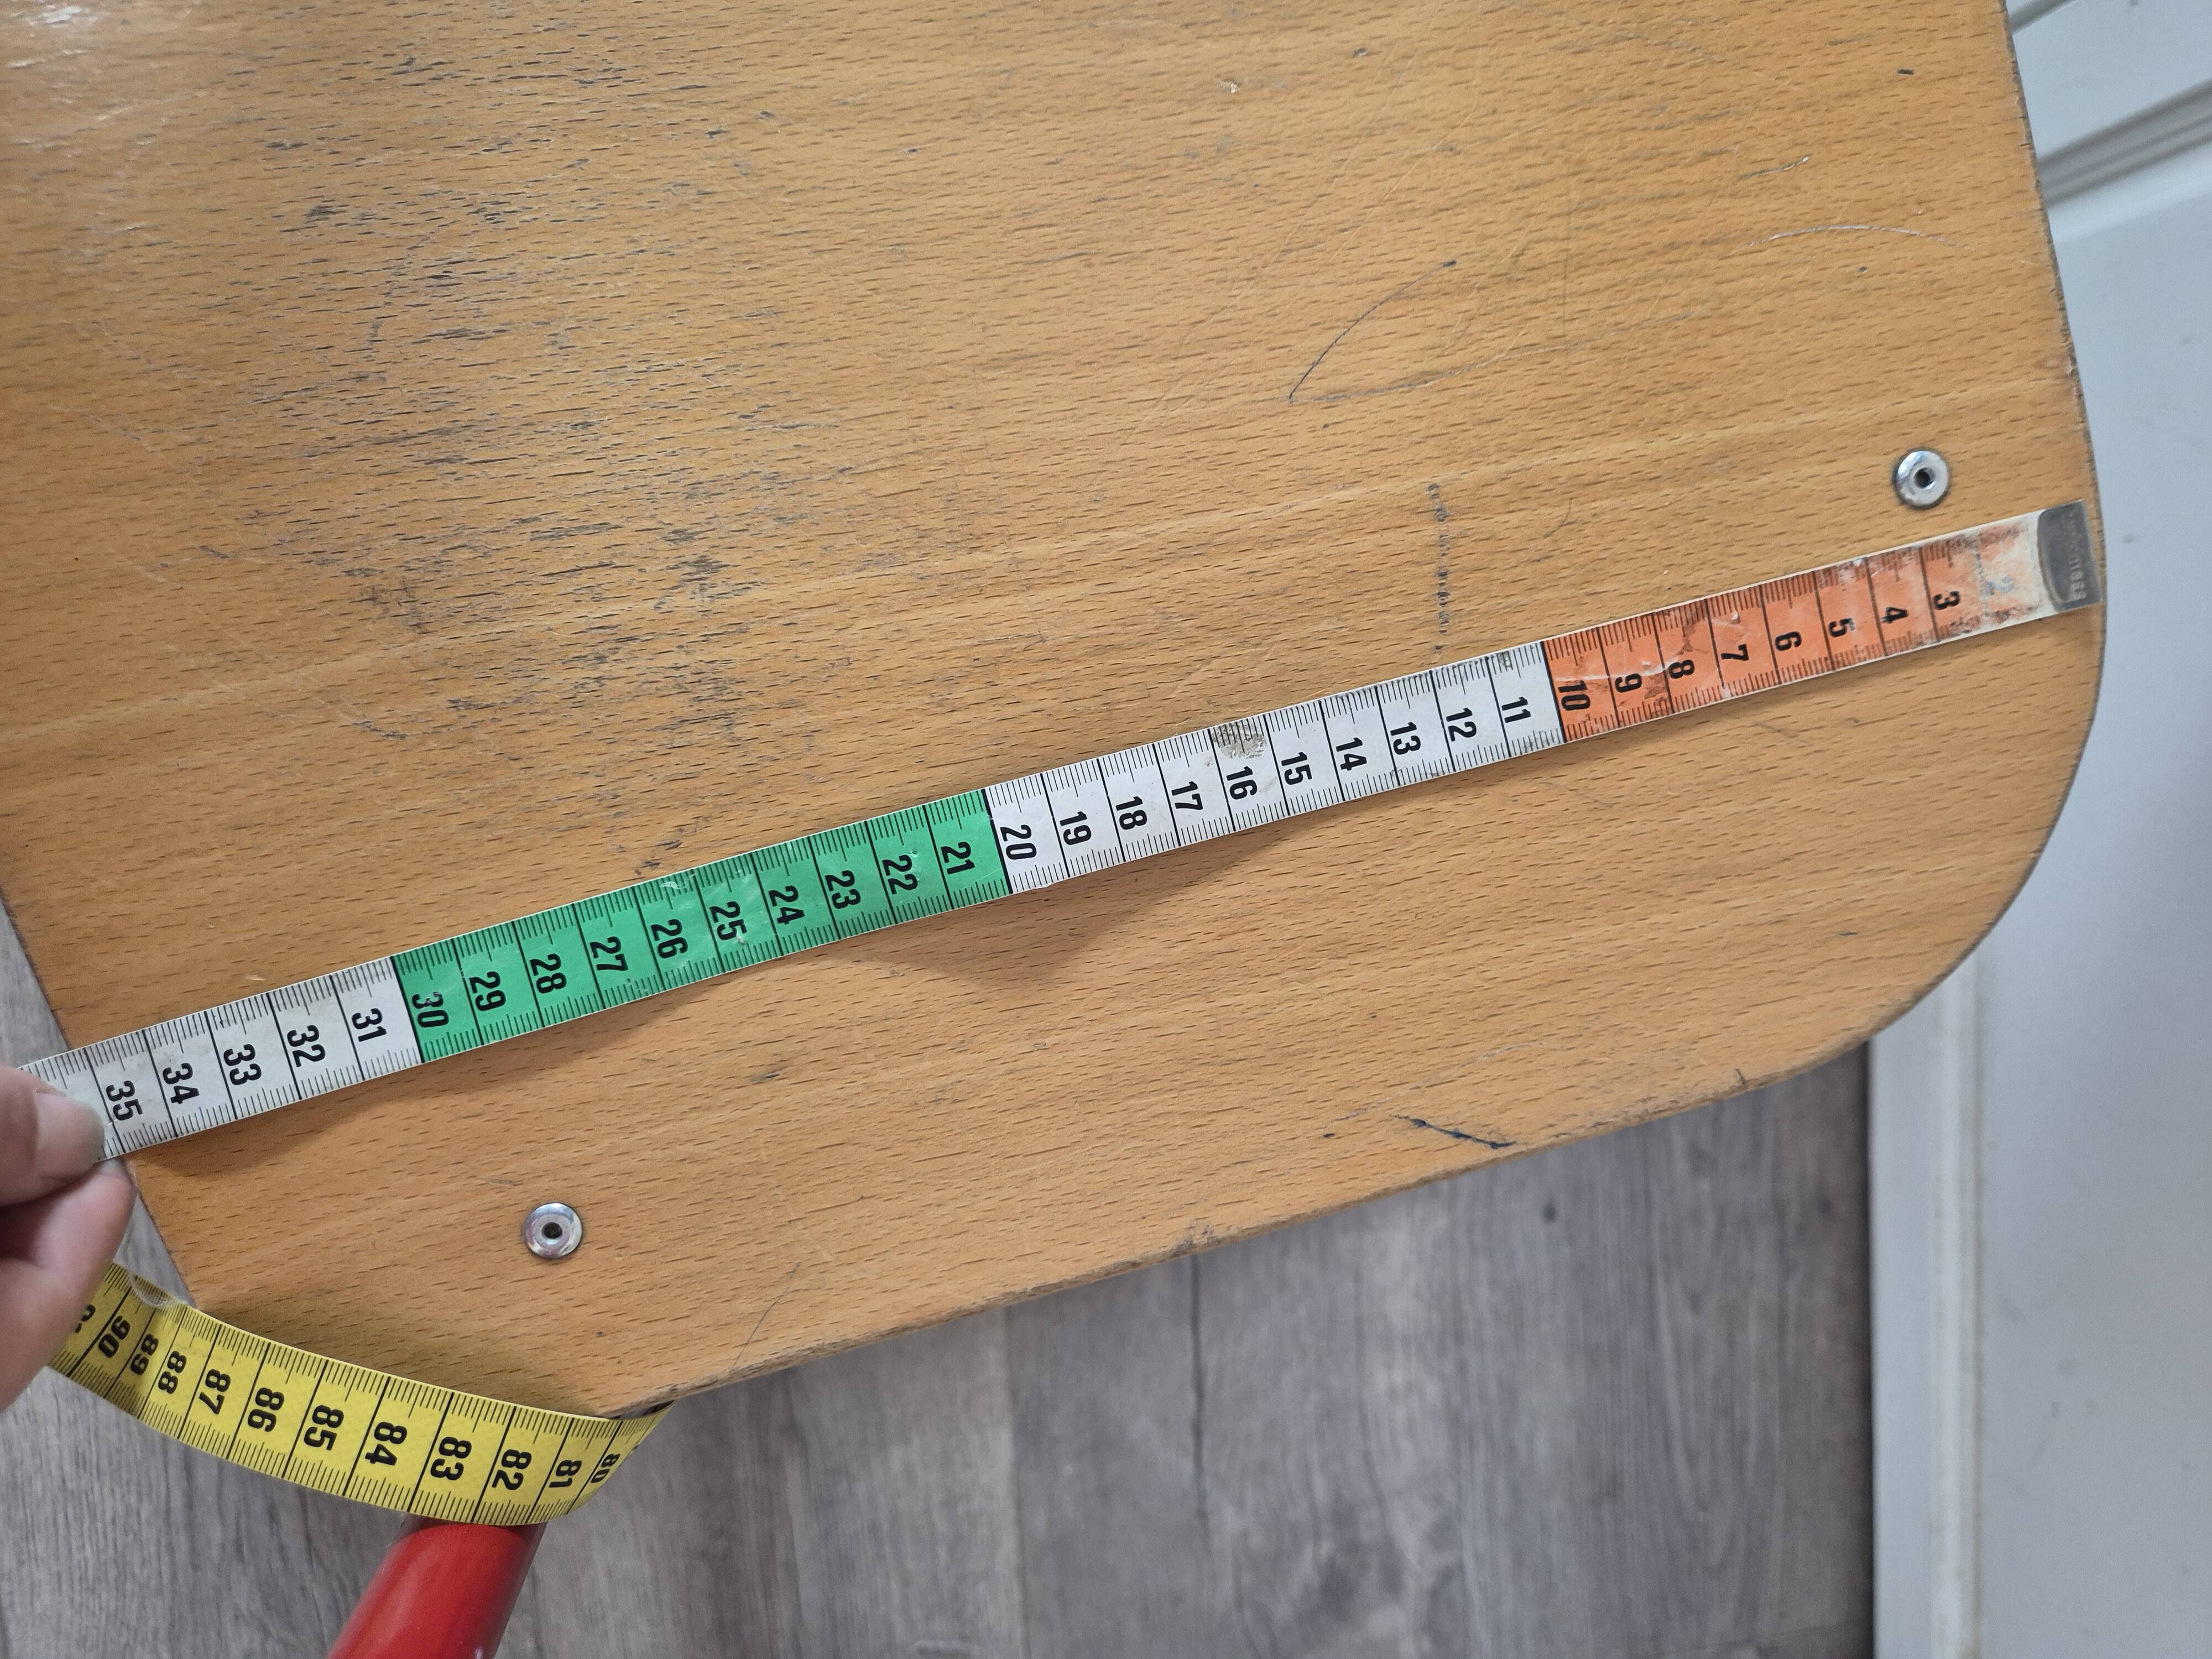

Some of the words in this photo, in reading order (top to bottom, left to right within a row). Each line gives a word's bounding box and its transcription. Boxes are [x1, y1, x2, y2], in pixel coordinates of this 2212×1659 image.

[1880, 606, 1908, 624] 4
[1933, 591, 1960, 610] 3
[1774, 630, 1802, 651] 6
[1829, 617, 1855, 638] 5
[1669, 659, 1695, 679] 8
[1720, 644, 1749, 661] 7
[1557, 680, 1590, 711] 10
[1614, 673, 1642, 693] 9
[1445, 707, 1477, 742] 12
[1501, 696, 1531, 723] 11
[1335, 737, 1367, 771] 14
[1390, 722, 1421, 755] 13
[1225, 765, 1258, 800] 16
[1281, 752, 1312, 785] 15
[1115, 796, 1147, 830] 18
[1171, 780, 1203, 811] 17
[1000, 824, 1037, 860] 20
[1060, 811, 1092, 846] 19
[881, 854, 919, 895] 22
[941, 841, 975, 874] 21
[769, 885, 805, 925] 24
[825, 870, 861, 909] 23
[709, 901, 748, 940] 25
[589, 936, 628, 972] 27
[651, 919, 688, 959] 26
[469, 971, 507, 1011] 29
[530, 953, 567, 993] 28
[351, 1008, 388, 1042] 31
[411, 991, 449, 1028] 30
[286, 1024, 326, 1067] 32
[163, 1062, 200, 1104] 34
[223, 1044, 262, 1086] 33
[106, 1081, 143, 1121] 35
[98, 1314, 131, 1358] 90
[129, 1334, 159, 1376] 89
[158, 1350, 187, 1394] 88
[199, 1369, 231, 1415] 87
[247, 1387, 285, 1432] 86
[304, 1405, 345, 1451] 85
[364, 1422, 408, 1467] 84
[430, 1437, 472, 1480] 83
[492, 1449, 531, 1490] 82
[549, 1459, 582, 1488] 81
[591, 1453, 620, 1483] 80
